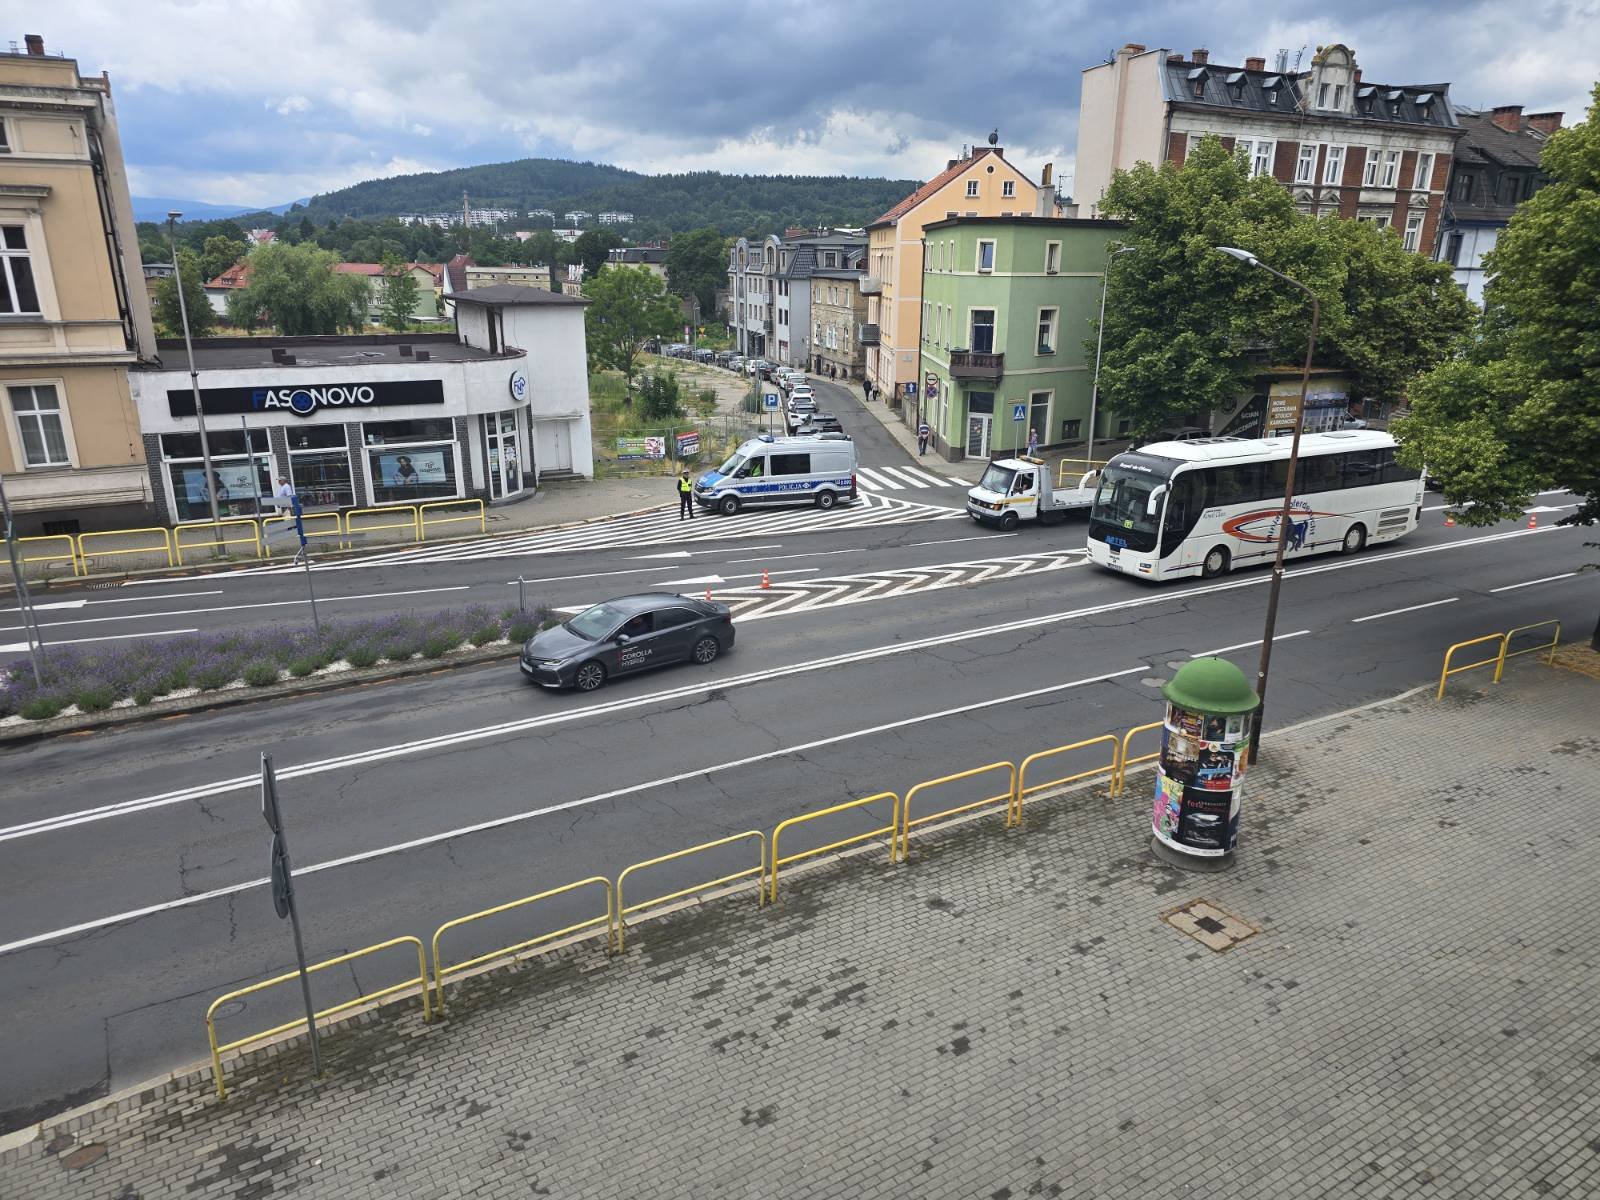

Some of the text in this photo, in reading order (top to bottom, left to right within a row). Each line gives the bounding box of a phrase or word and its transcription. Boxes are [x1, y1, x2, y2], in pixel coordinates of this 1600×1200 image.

[252, 386, 375, 413] FASONOVO
[767, 394, 776, 405] P
[778, 483, 802, 491] POLICJA
[622, 649, 652, 660] COROLLA
